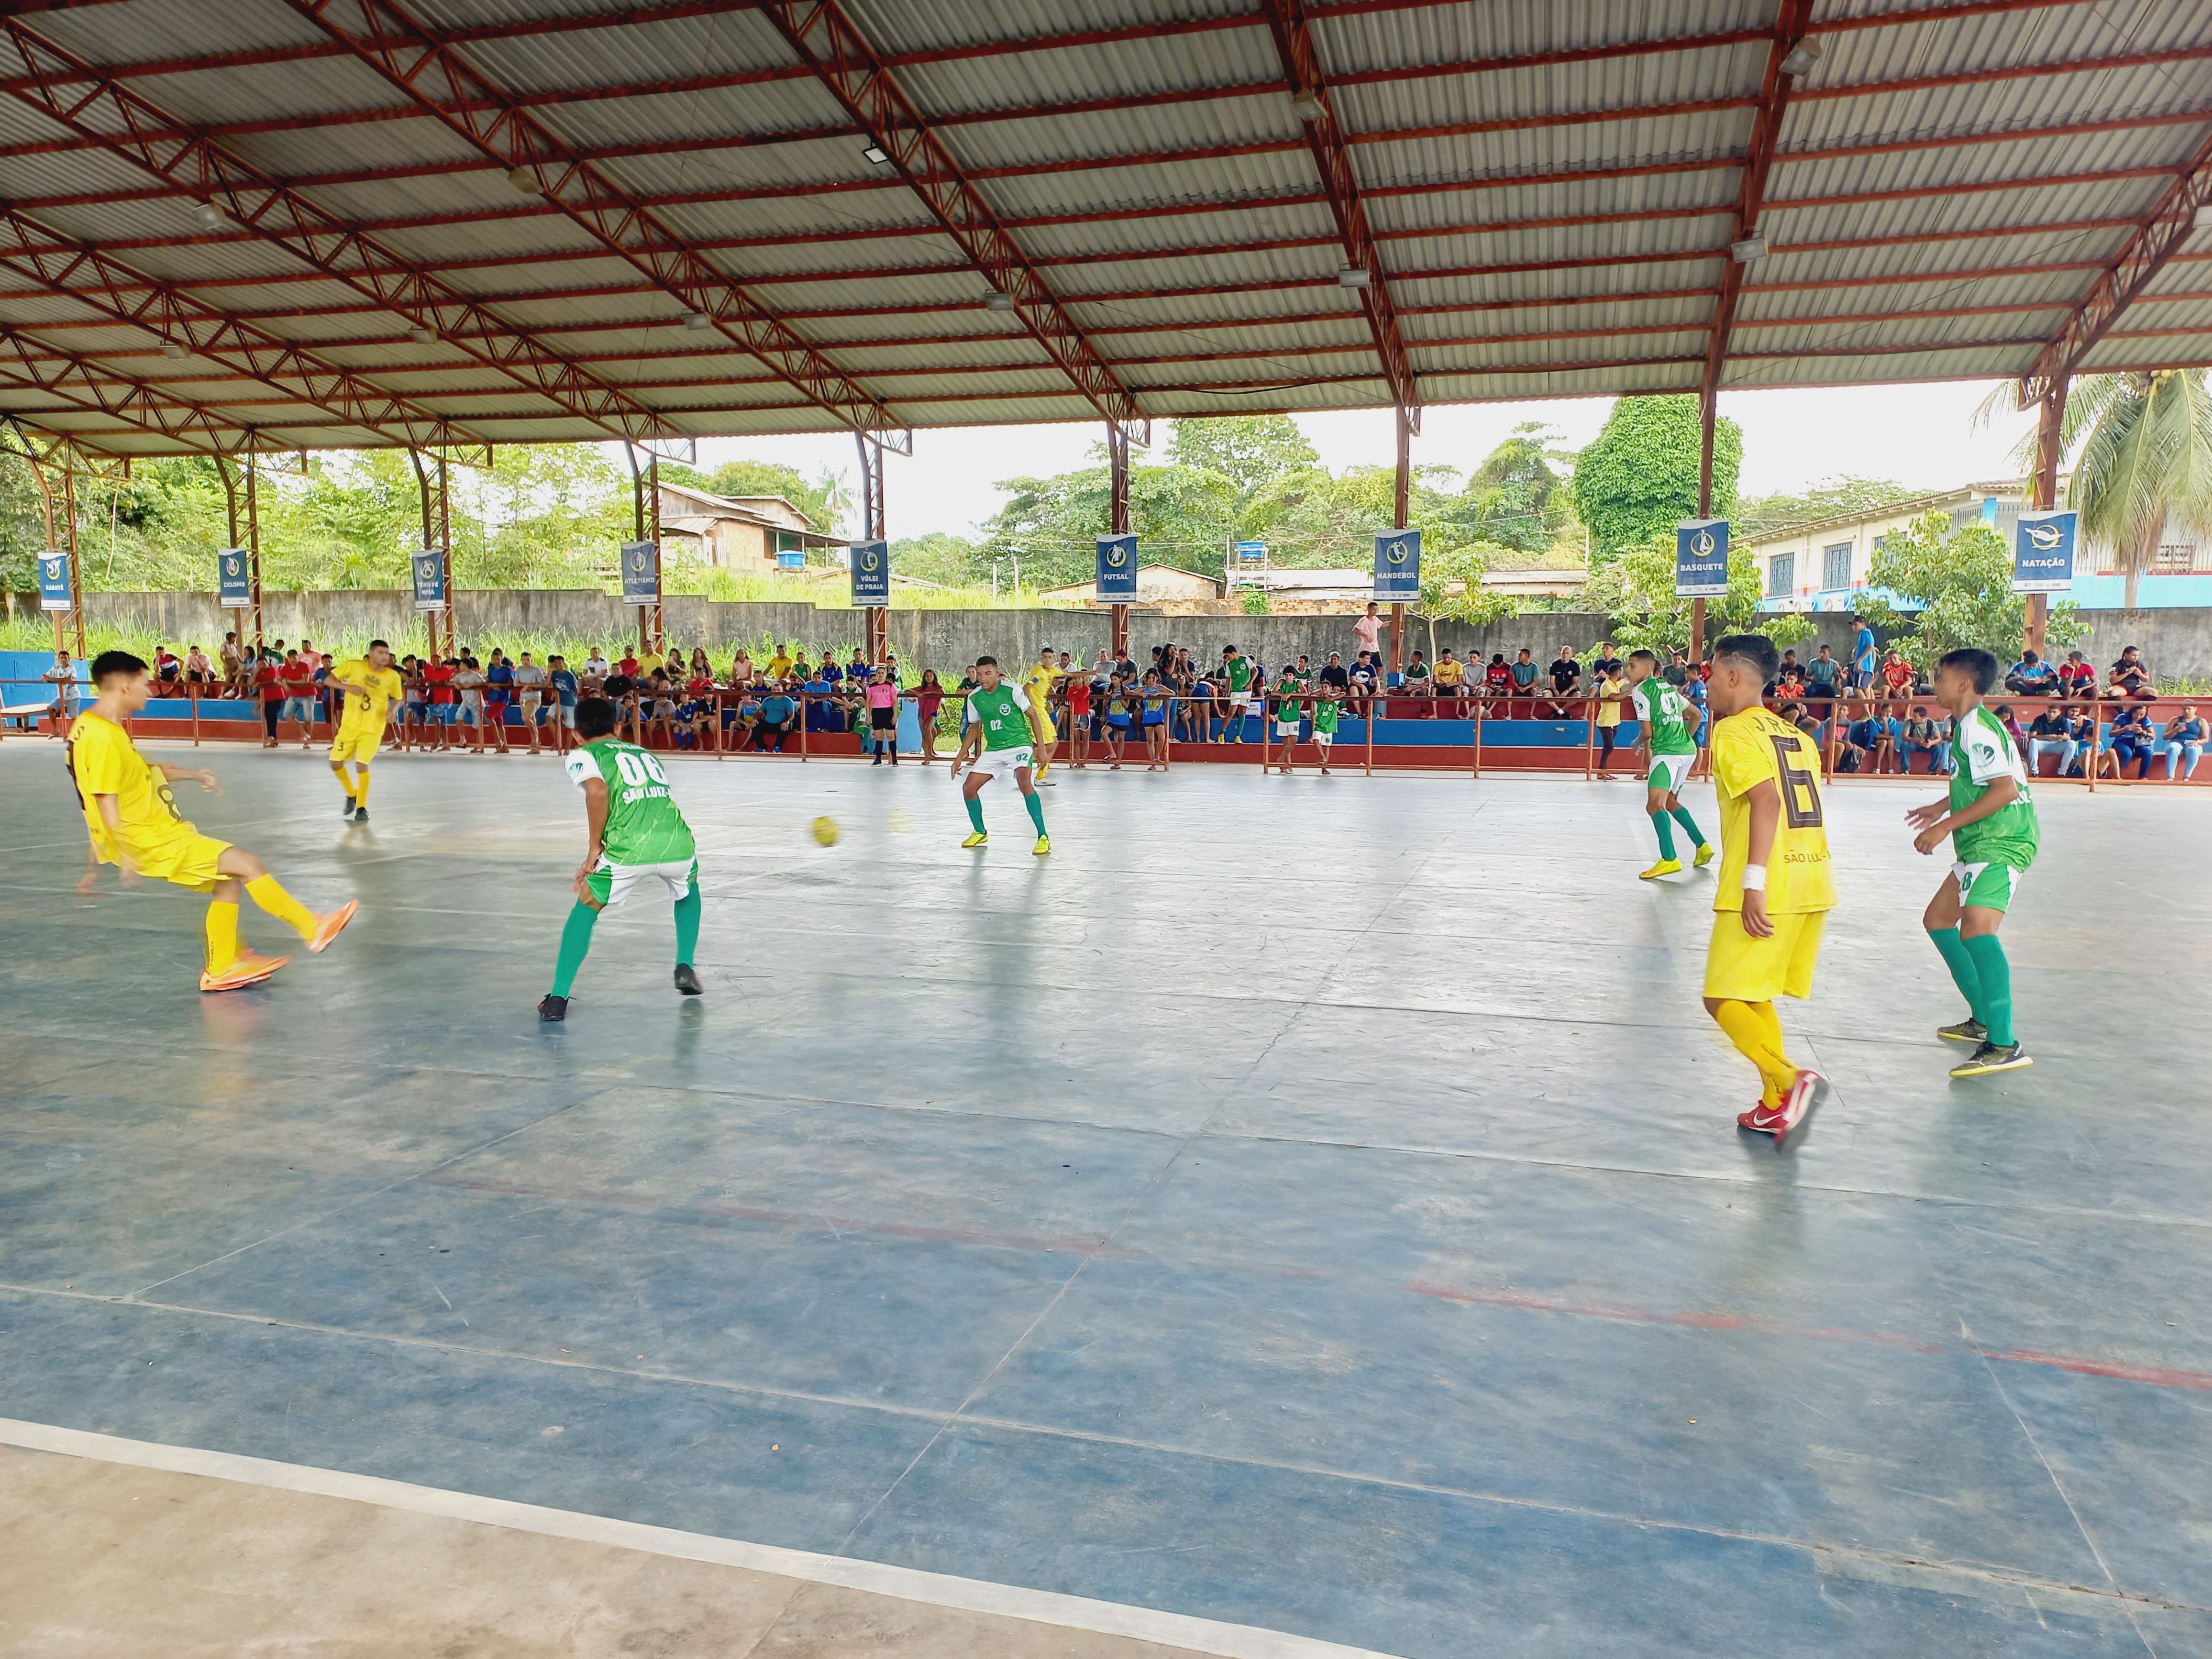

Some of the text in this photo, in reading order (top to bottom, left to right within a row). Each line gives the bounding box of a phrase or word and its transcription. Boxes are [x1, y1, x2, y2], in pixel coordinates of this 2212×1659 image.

[1680, 563, 1724, 572] BASQUETE
[2022, 557, 2066, 569] NATAÇÃO
[360, 694, 371, 711] 3
[990, 719, 1003, 731] 02
[1016, 753, 1028, 762] 02
[615, 752, 669, 786] 06
[1769, 735, 1822, 829] 6
[622, 788, 645, 805] SÃO
[1784, 850, 1805, 863] SÃO
